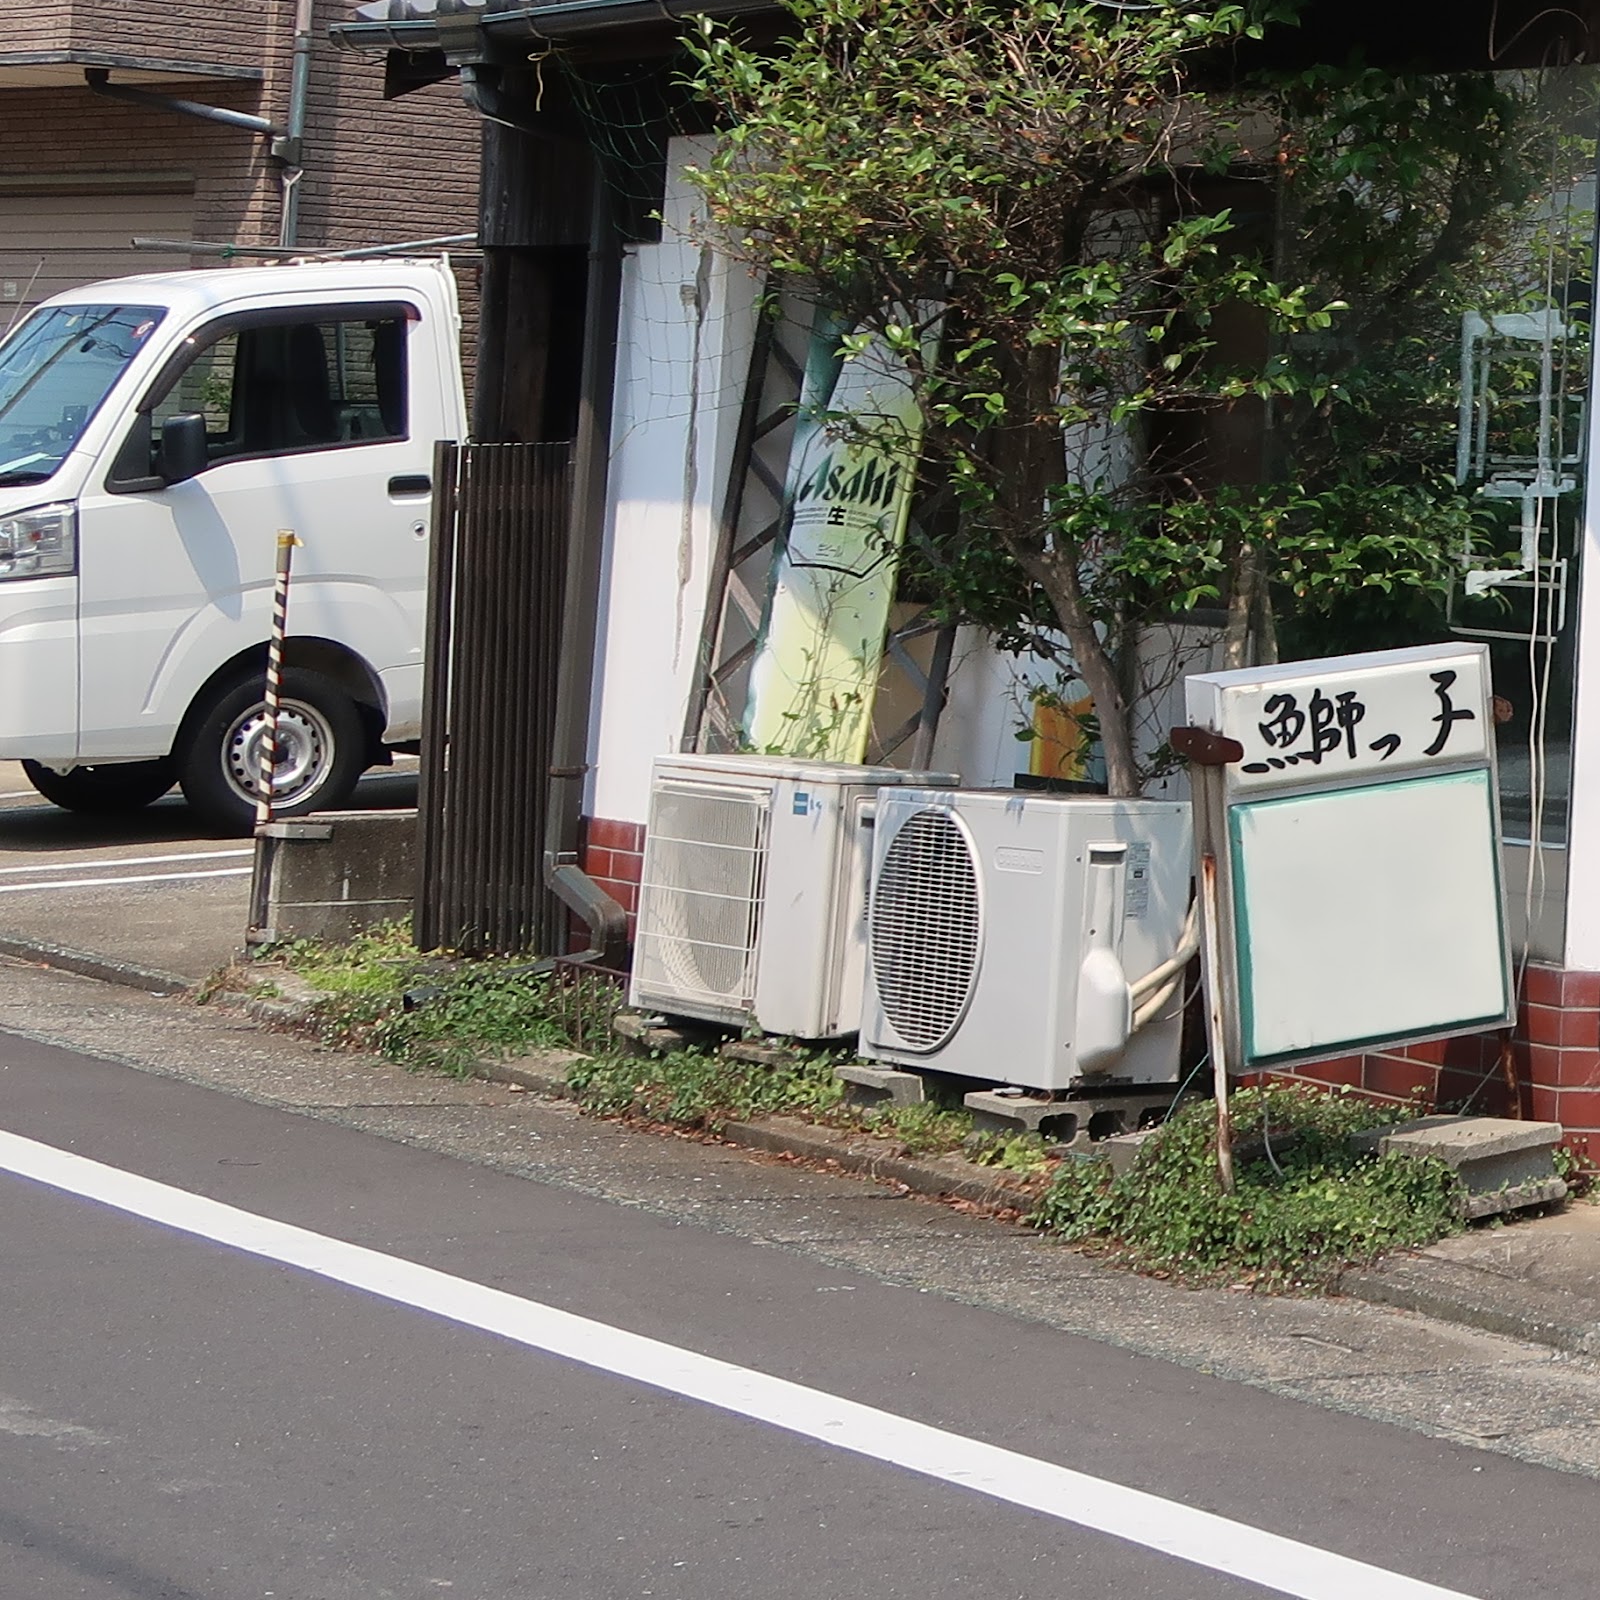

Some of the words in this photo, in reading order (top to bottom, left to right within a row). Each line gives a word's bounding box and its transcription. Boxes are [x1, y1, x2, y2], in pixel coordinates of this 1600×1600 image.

[800, 451, 900, 510] Asahi
[827, 505, 846, 526] 生
[1241, 670, 1475, 773] 鰤っ子
